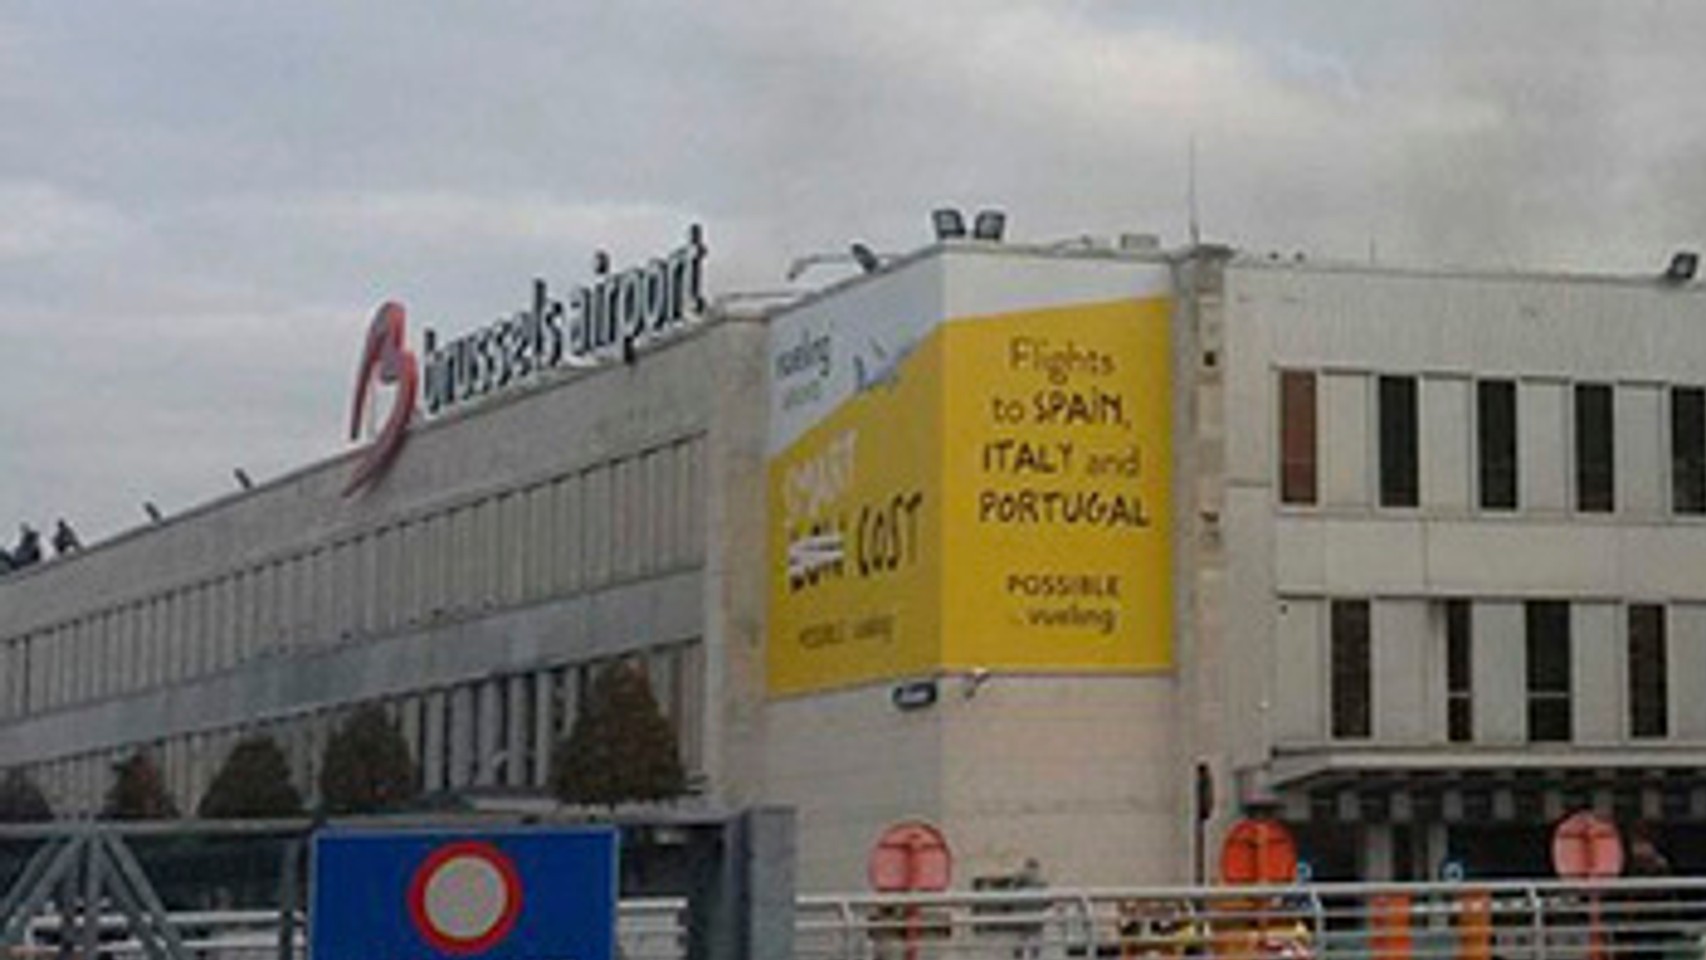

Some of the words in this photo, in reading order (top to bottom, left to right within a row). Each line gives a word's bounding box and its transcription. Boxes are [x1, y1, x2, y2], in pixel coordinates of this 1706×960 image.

[424, 278, 563, 414] brussels
[570, 223, 708, 365] airport
[1008, 336, 1117, 386] Flights
[993, 396, 1025, 425] to
[981, 438, 1074, 475] ITALY
[1086, 445, 1141, 479] and
[978, 490, 1151, 528] PORTUGAL
[857, 491, 923, 578] COST
[1006, 573, 1121, 599] POSSIBLE
[1027, 604, 1118, 634] vueling
